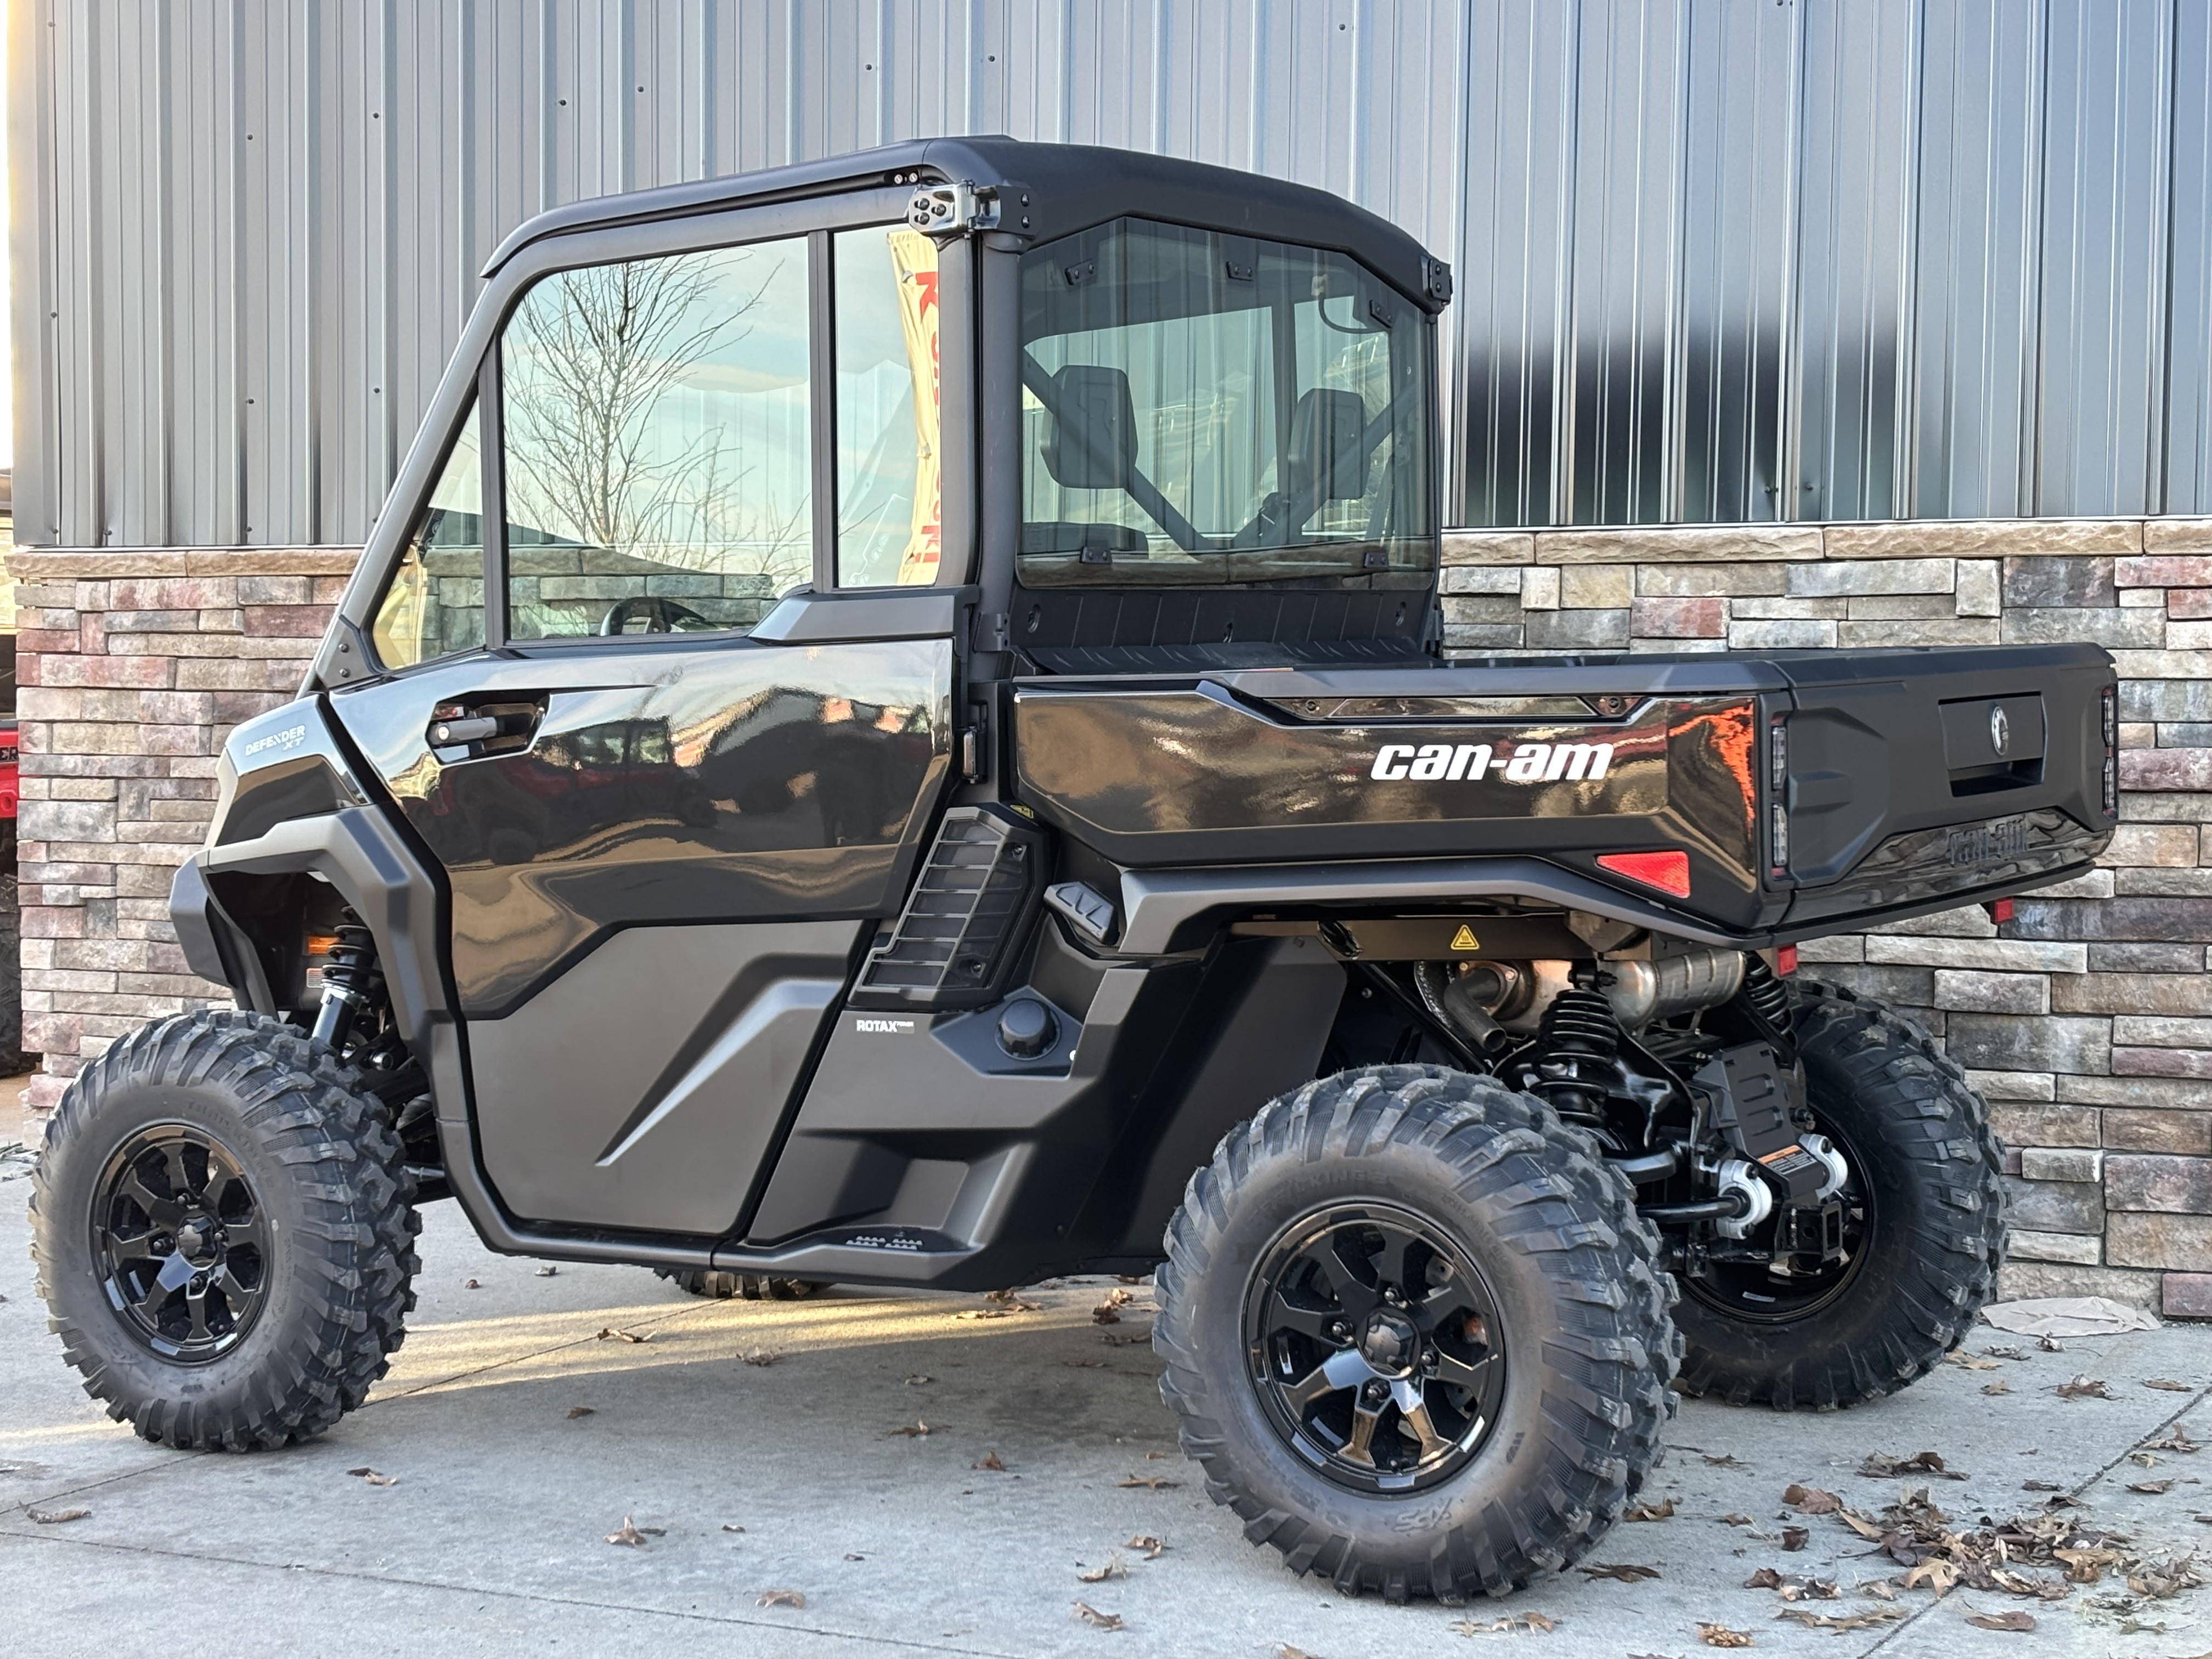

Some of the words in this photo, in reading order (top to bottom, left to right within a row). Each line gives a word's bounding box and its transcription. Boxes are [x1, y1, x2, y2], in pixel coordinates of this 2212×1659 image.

[245, 725, 305, 755] DEFENDER
[283, 737, 304, 751] XT
[1371, 743, 1614, 780] can-am
[856, 1020, 898, 1032] ROTAX
